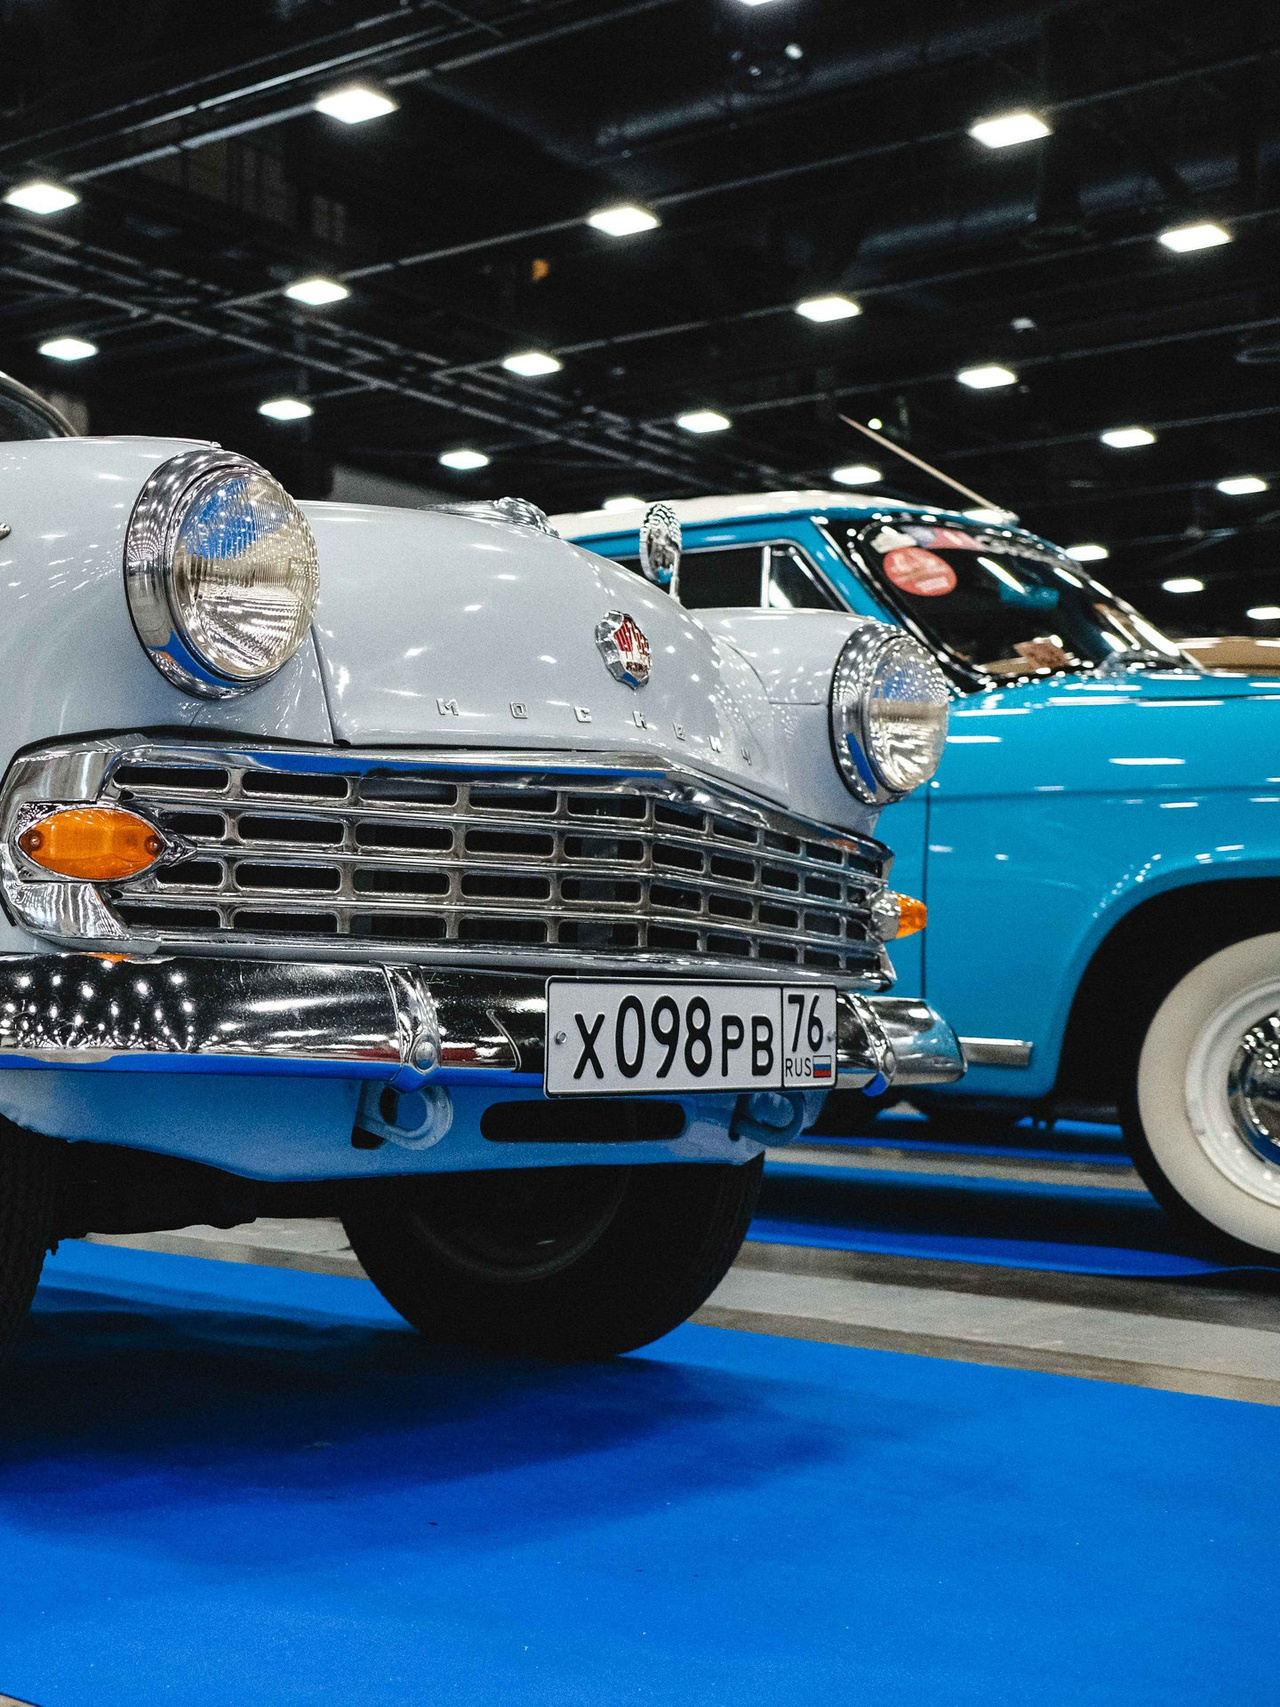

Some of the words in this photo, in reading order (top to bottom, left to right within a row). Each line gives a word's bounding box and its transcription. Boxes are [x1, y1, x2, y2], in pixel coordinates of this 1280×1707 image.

[437, 698, 753, 767] МОСКВИЧ
[787, 994, 824, 1053] 76
[785, 1057, 812, 1077] RUS
